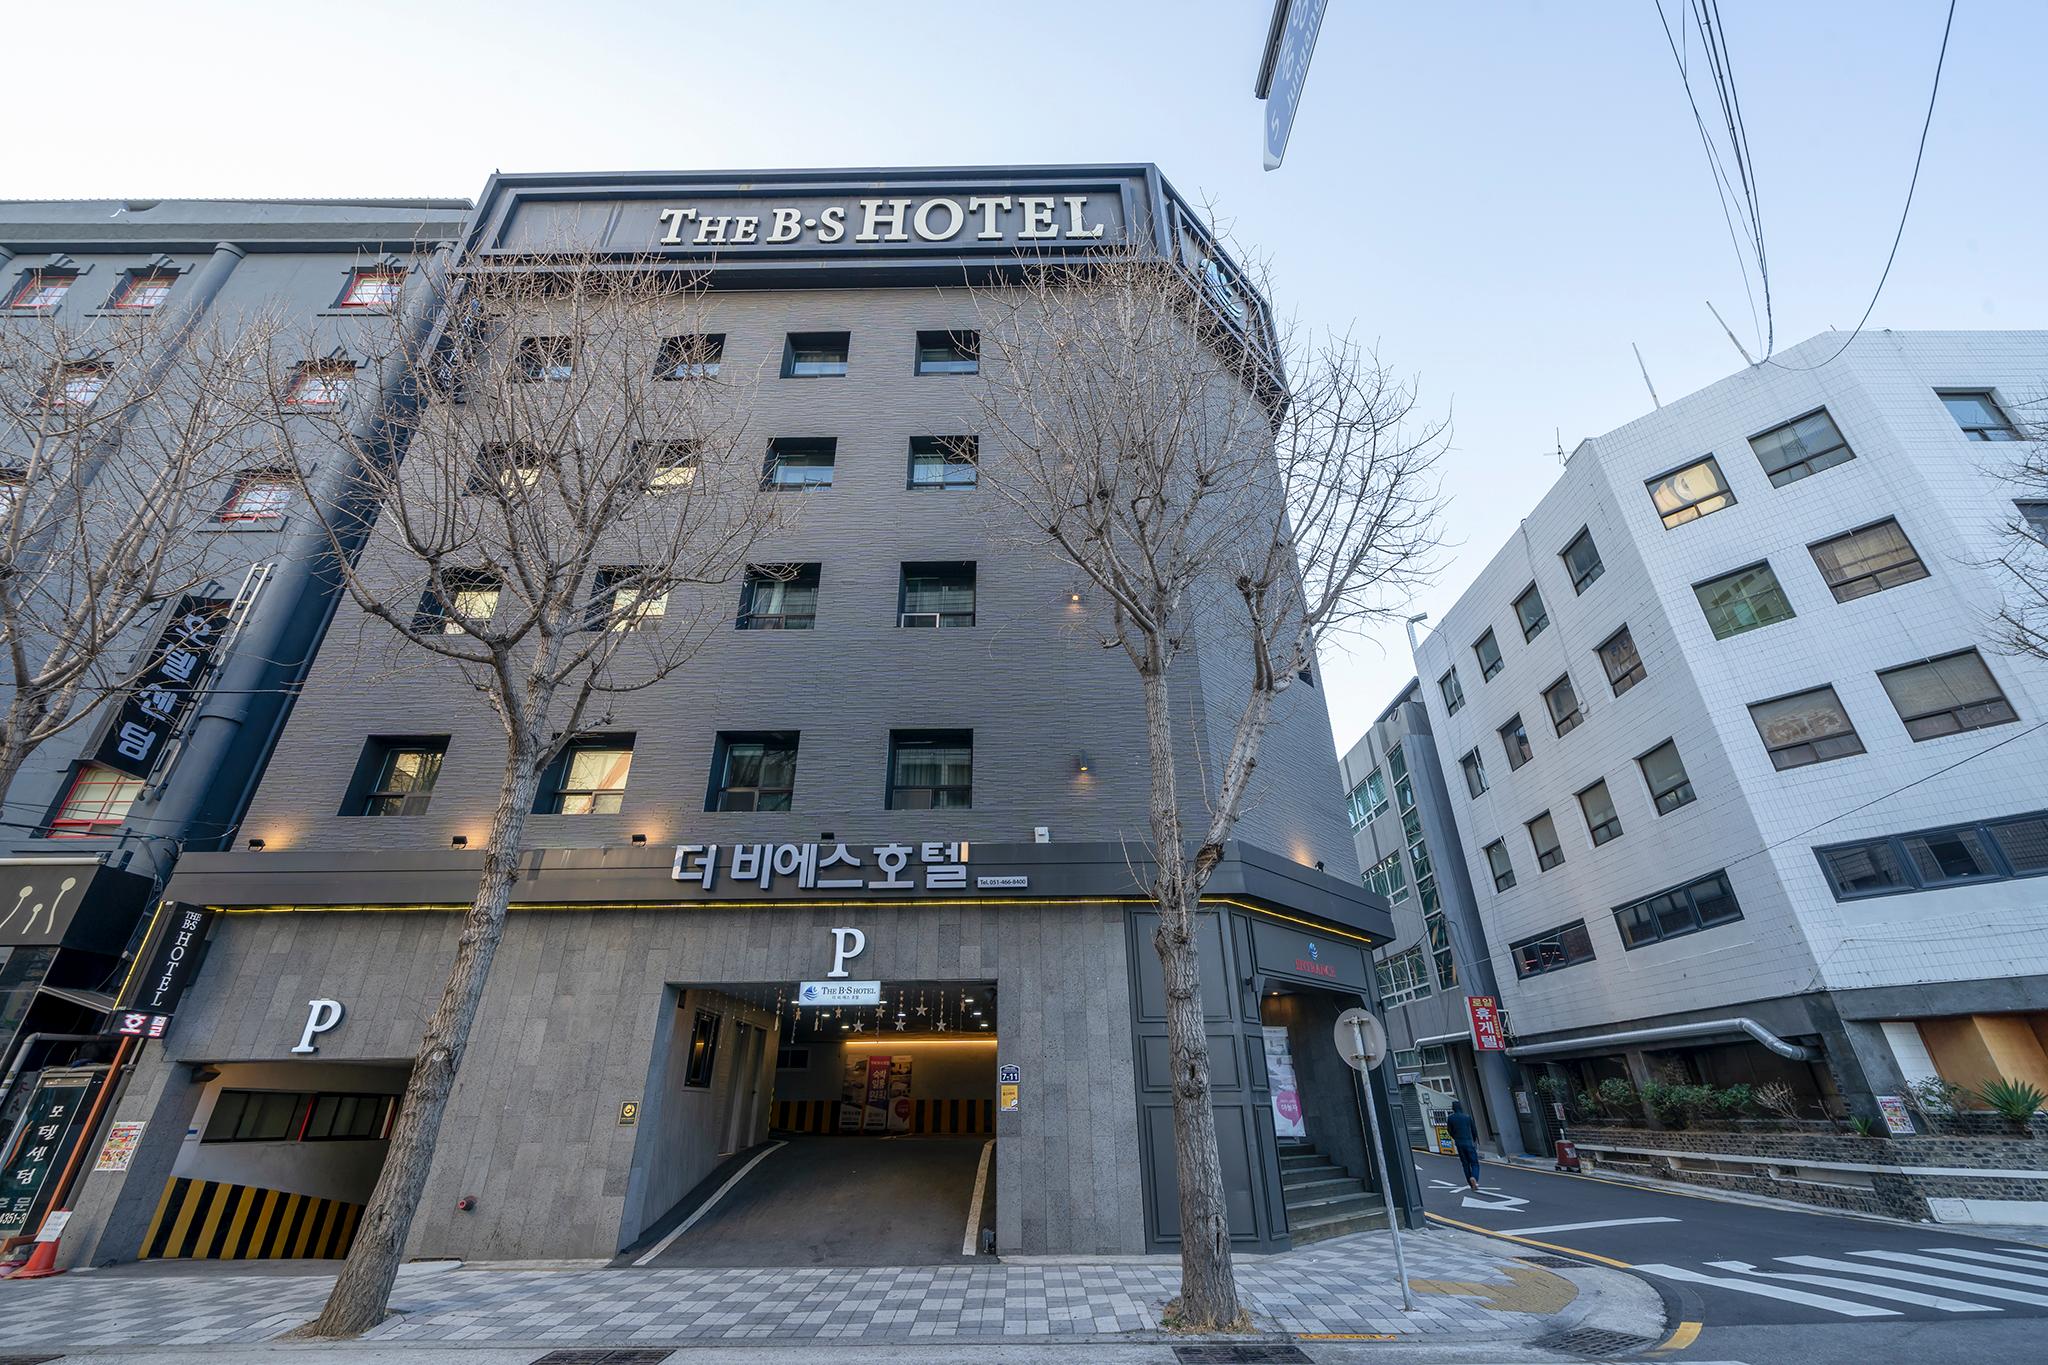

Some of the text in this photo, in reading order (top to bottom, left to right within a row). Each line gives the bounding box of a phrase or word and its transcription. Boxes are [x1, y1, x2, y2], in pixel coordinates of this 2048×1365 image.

[660, 208, 760, 245] THE
[855, 195, 1105, 242] HOTEL
[671, 843, 718, 890] 더
[185, 911, 202, 922] THE
[150, 931, 193, 1007] HOTEL
[827, 927, 867, 979] P
[821, 986, 837, 995] THE
[853, 987, 876, 995] HOTEL
[290, 997, 346, 1054] P
[1002, 1073, 1018, 1081] 7-11
[17, 1104, 65, 1185] 모텔센텀
